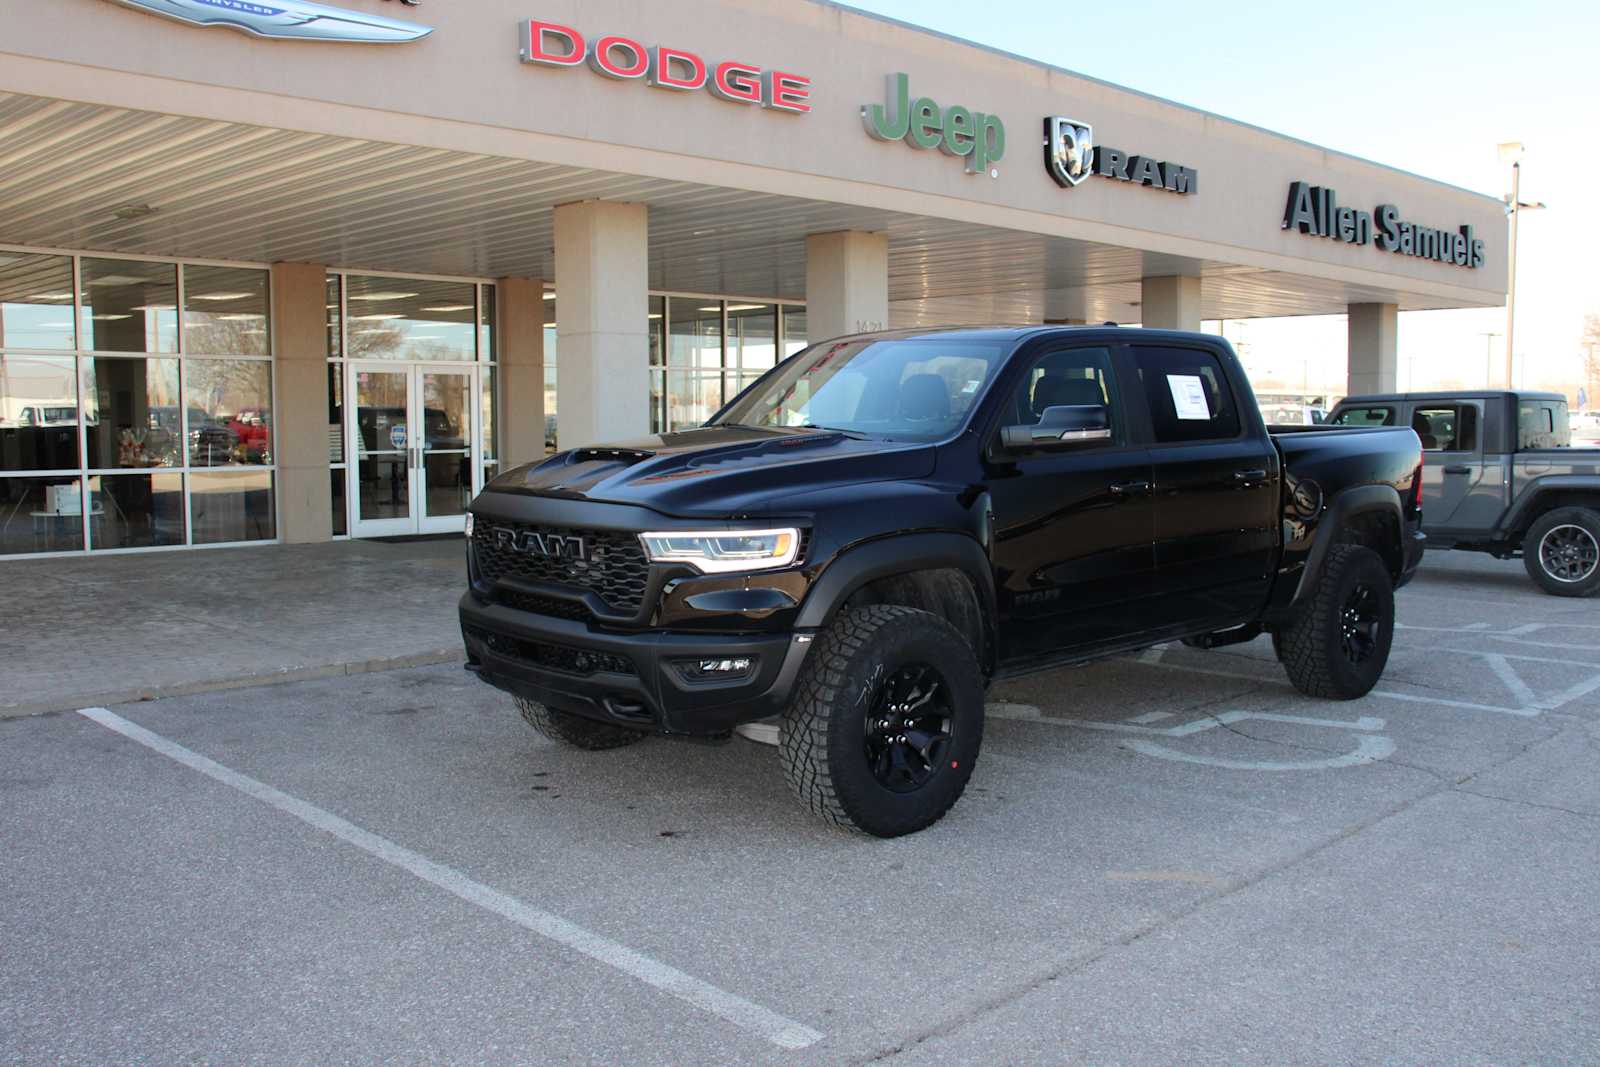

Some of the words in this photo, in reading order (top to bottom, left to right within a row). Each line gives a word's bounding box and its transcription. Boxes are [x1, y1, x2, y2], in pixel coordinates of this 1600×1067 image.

[519, 17, 812, 113] DODGE
[860, 71, 1006, 176] Jeep
[1092, 145, 1198, 195] RAM
[1282, 181, 1372, 246] Allen
[1373, 203, 1485, 269] Samuels
[492, 525, 585, 560] RAM
